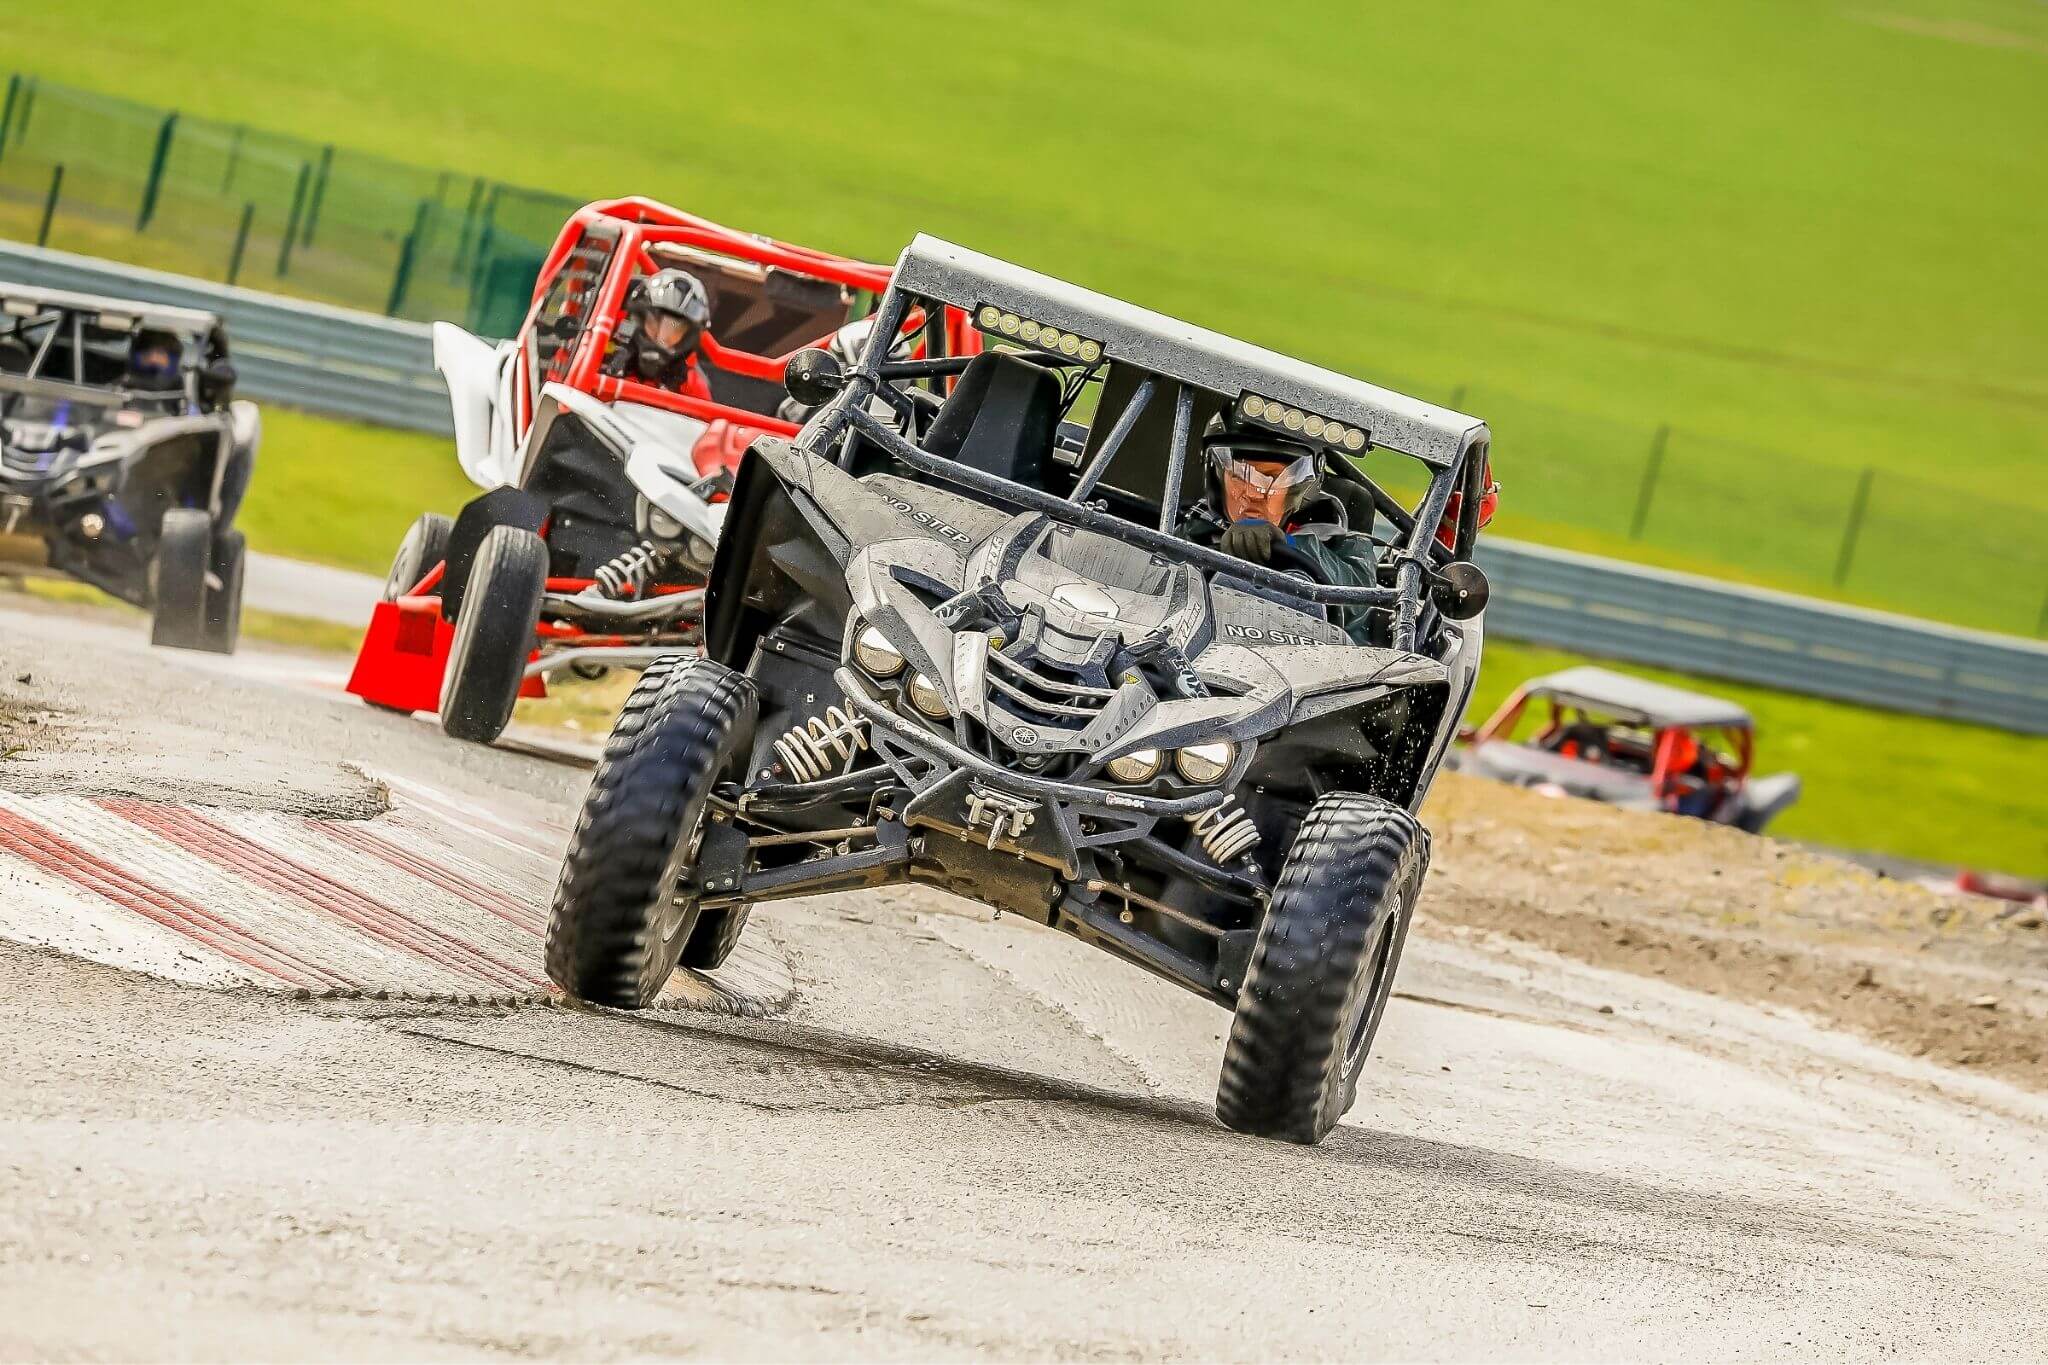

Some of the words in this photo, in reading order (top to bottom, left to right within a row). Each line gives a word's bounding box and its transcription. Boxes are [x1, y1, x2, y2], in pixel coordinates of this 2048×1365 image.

[882, 494, 913, 513] NO
[912, 511, 972, 543] STEP
[1225, 624, 1264, 640] NO
